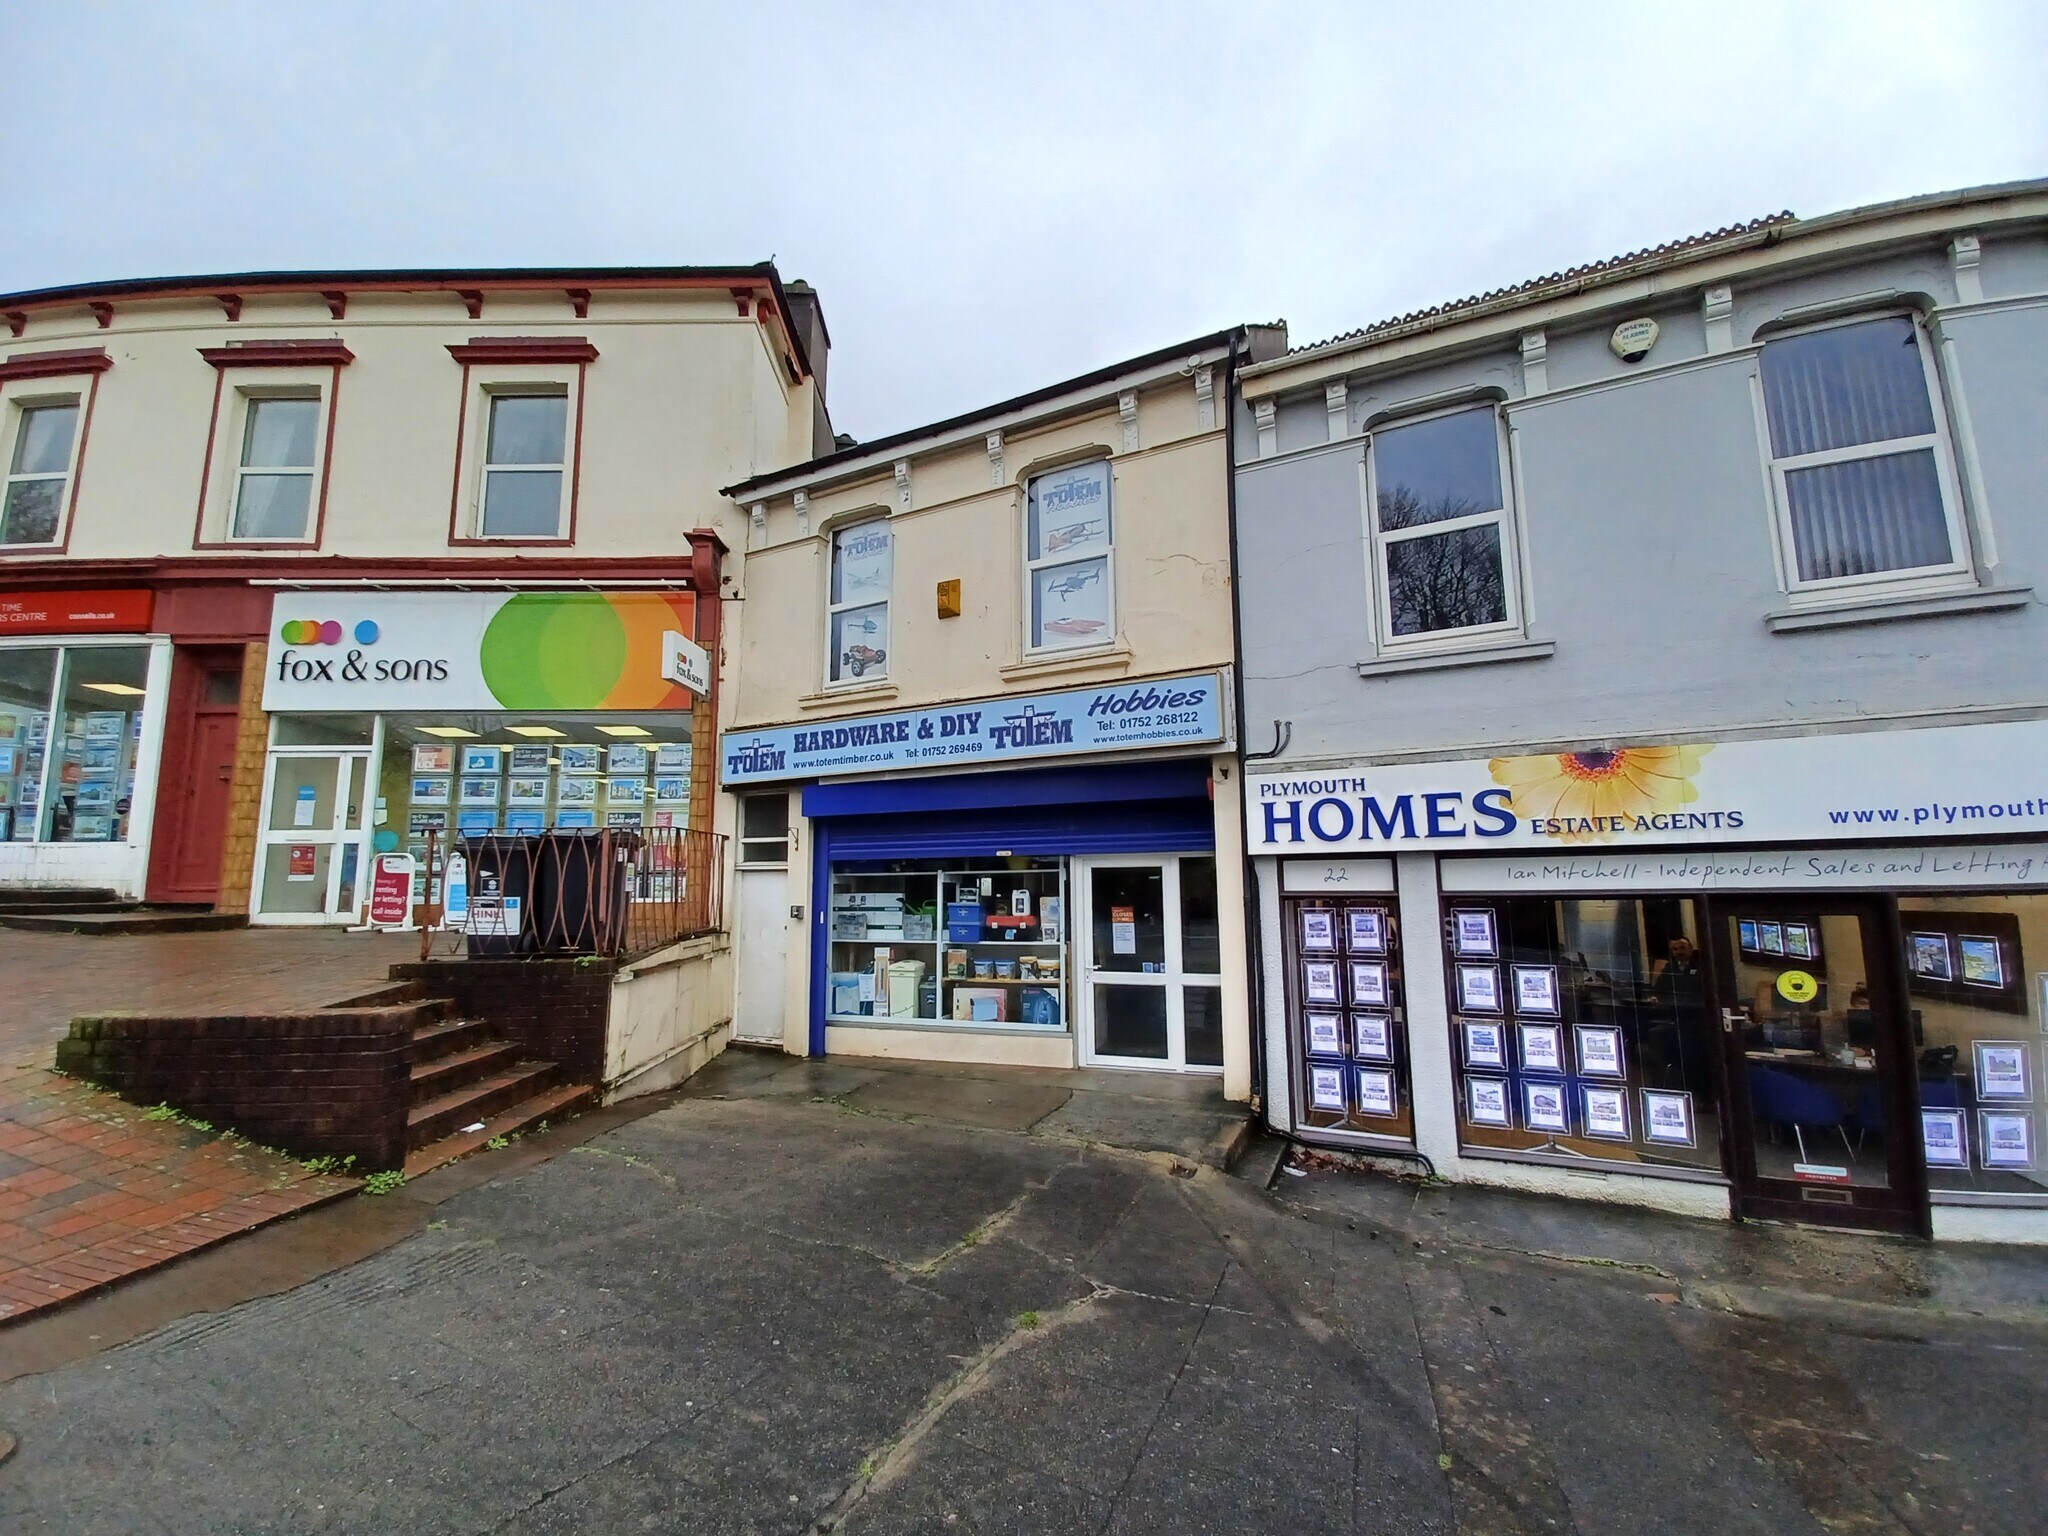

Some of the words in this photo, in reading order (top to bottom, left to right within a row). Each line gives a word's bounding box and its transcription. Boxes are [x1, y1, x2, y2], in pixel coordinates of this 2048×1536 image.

[1043, 476, 1101, 507] TOTEM
[1046, 496, 1101, 514] Hobbies
[844, 530, 888, 557] TOTEM
[2, 603, 23, 611] TIME
[10, 612, 48, 622] CENTRE
[277, 649, 334, 682] fox
[342, 649, 368, 681] &
[374, 659, 448, 681] sons
[676, 663, 686, 678] fox
[692, 674, 703, 686] sons
[1087, 687, 1207, 717] Hobbies
[989, 705, 1073, 750] TOTEM
[1097, 720, 1115, 731] Tel:
[1120, 716, 1152, 729] 01752
[1156, 711, 1198, 725] 268122
[793, 720, 910, 753] HARDWARE
[917, 718, 934, 740] &
[940, 711, 982, 737] DIY
[1093, 726, 1203, 743] www.totemhobbies.co.uk
[728, 738, 785, 775] TOTEM
[793, 751, 894, 769] www.totemtimber.co.uk
[905, 748, 919, 758] Tel:
[922, 745, 947, 757] 01752
[949, 742, 982, 755] 269469
[1260, 778, 1366, 797] PLYMOUTH
[1261, 789, 1517, 843] HOMES
[1531, 816, 1625, 834] ESTATE
[1633, 811, 1744, 831] AGENTS
[1323, 868, 1349, 883] 22
[1507, 866, 1537, 879] Ian
[1542, 860, 1638, 880] Mitchell
[1660, 856, 1796, 886] Independent
[1804, 857, 1876, 878] Sales
[1883, 852, 1925, 874] and
[1934, 851, 2033, 880] Letting
[376, 886, 398, 895] renting
[382, 896, 406, 905] letting?
[373, 907, 384, 915] call
[384, 907, 403, 916] inside
